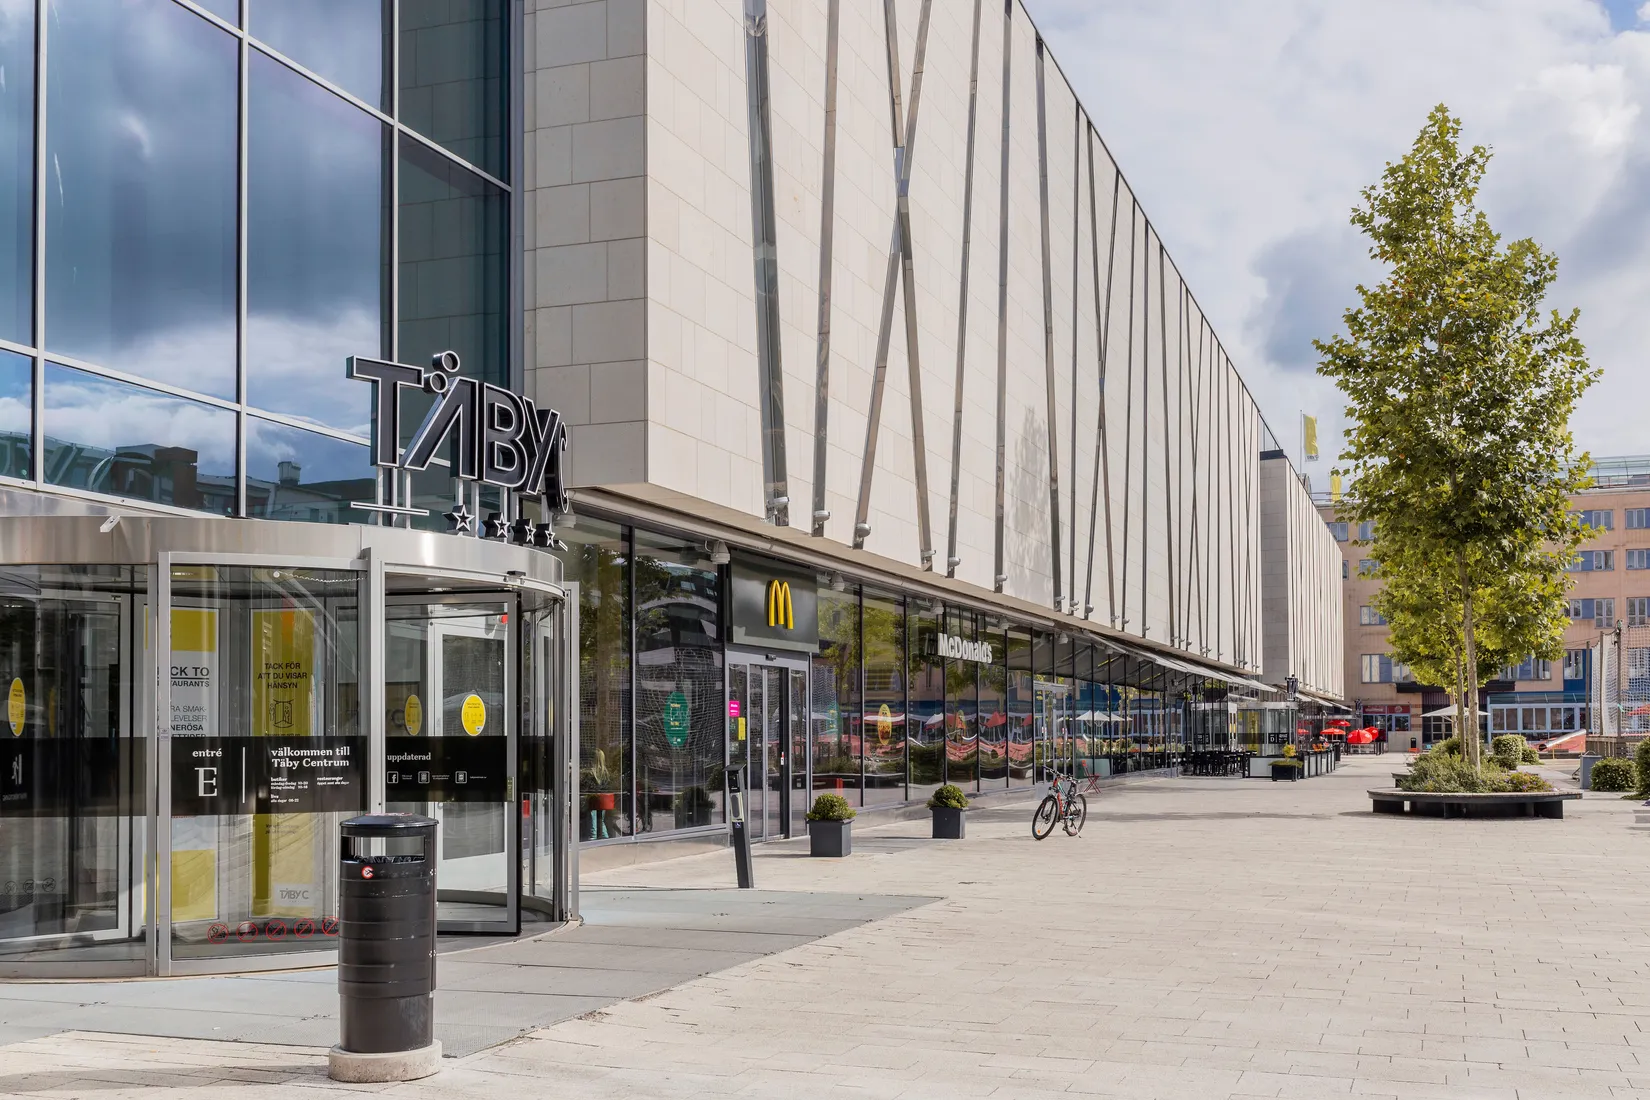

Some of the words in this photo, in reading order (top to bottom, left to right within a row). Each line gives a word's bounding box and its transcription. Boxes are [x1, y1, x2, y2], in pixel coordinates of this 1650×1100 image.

[346, 350, 560, 495] TÄBY
[937, 632, 993, 664] McDonald's
[264, 662, 284, 670] TACK
[285, 661, 301, 670] FÖR
[192, 666, 210, 677] TO
[257, 672, 271, 680] ATT
[272, 672, 284, 680] DU
[267, 681, 298, 689] HÄNSYN
[182, 705, 207, 713] SMAK-
[192, 748, 222, 758] entré
[270, 746, 333, 757] välkommen
[335, 746, 350, 756] till
[387, 752, 432, 763] uppdaterad
[271, 758, 300, 770] Täby
[302, 757, 350, 767] Centrum
[194, 766, 218, 797] E
[279, 887, 301, 900] TÄBY
